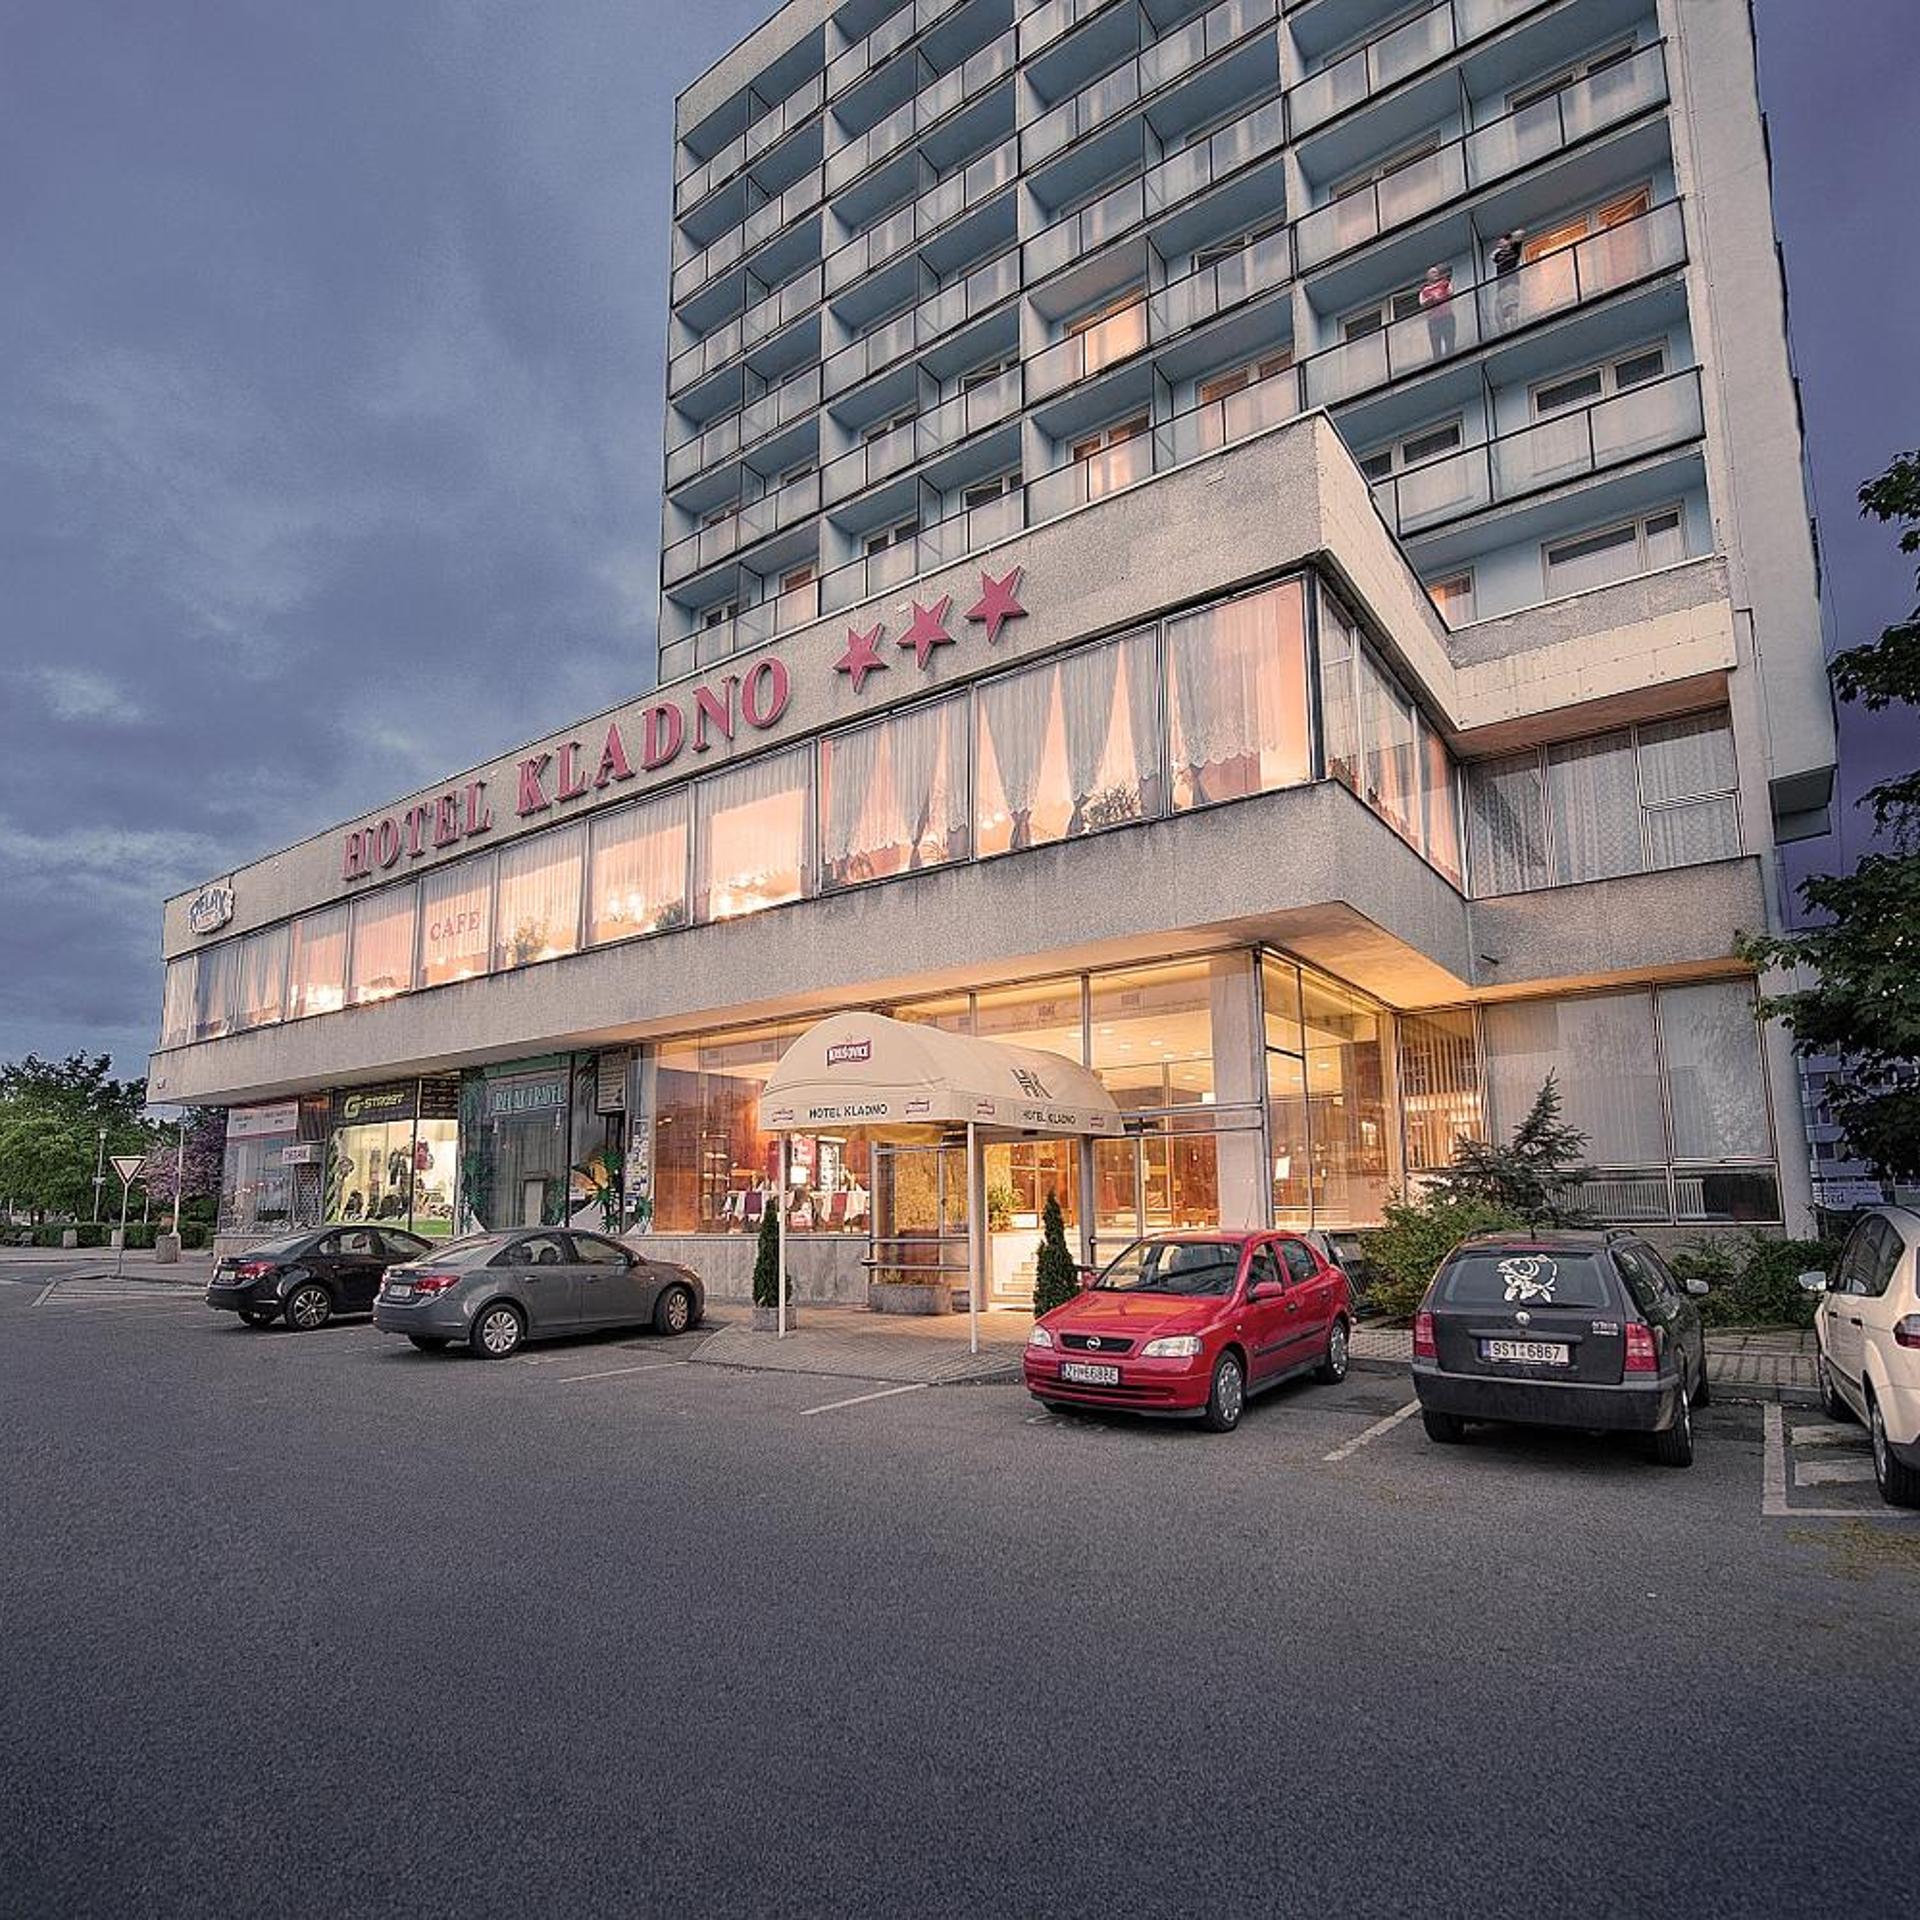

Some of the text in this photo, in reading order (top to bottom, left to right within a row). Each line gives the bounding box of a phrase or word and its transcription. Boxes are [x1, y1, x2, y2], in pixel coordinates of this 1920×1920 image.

[341, 656, 790, 882] HOTEL KLADNO
[430, 911, 480, 941] CAFE
[809, 1106, 841, 1119] HOTEL
[843, 1103, 888, 1117] KLADNO
[1023, 1110, 1046, 1122] HOTEL
[1047, 1112, 1076, 1125] KLADNO
